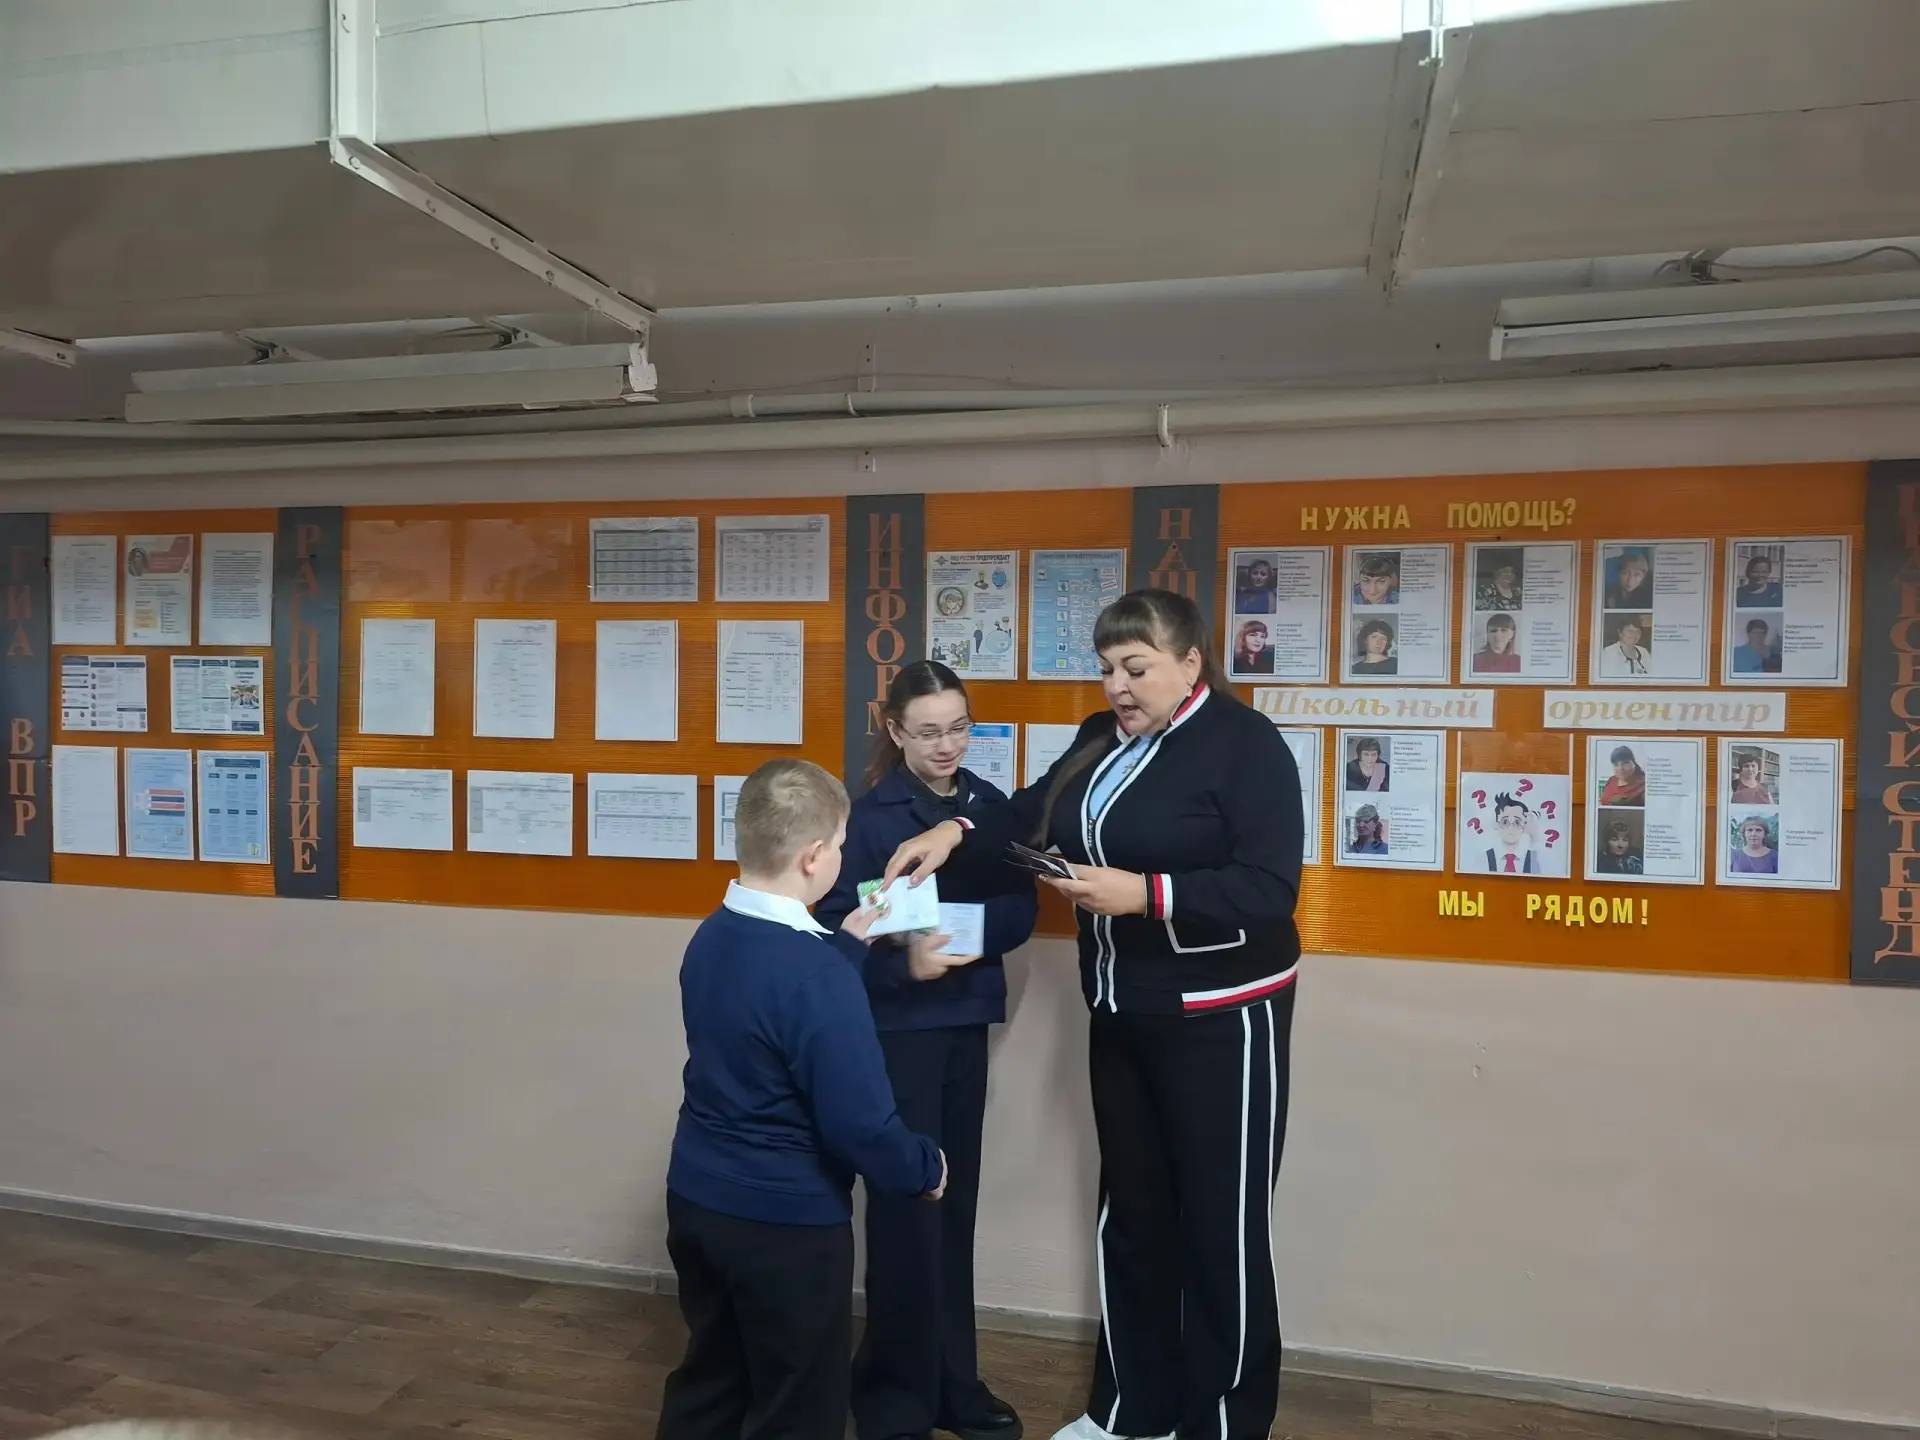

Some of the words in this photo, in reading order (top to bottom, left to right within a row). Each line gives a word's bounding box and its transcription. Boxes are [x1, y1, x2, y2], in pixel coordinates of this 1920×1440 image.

[1301, 504, 1411, 531] НУЖНА
[1447, 498, 1577, 531] ПОМОЩЬ?
[7, 546, 34, 656] ГИА
[286, 524, 324, 874] РАСПИСАНИЕ
[1259, 690, 1479, 719] Школьный
[1549, 700, 1772, 729] ориентир
[8, 717, 36, 836] ВПР
[1438, 890, 1485, 918] МЫ
[1526, 894, 1649, 927] РЯДОМ!
